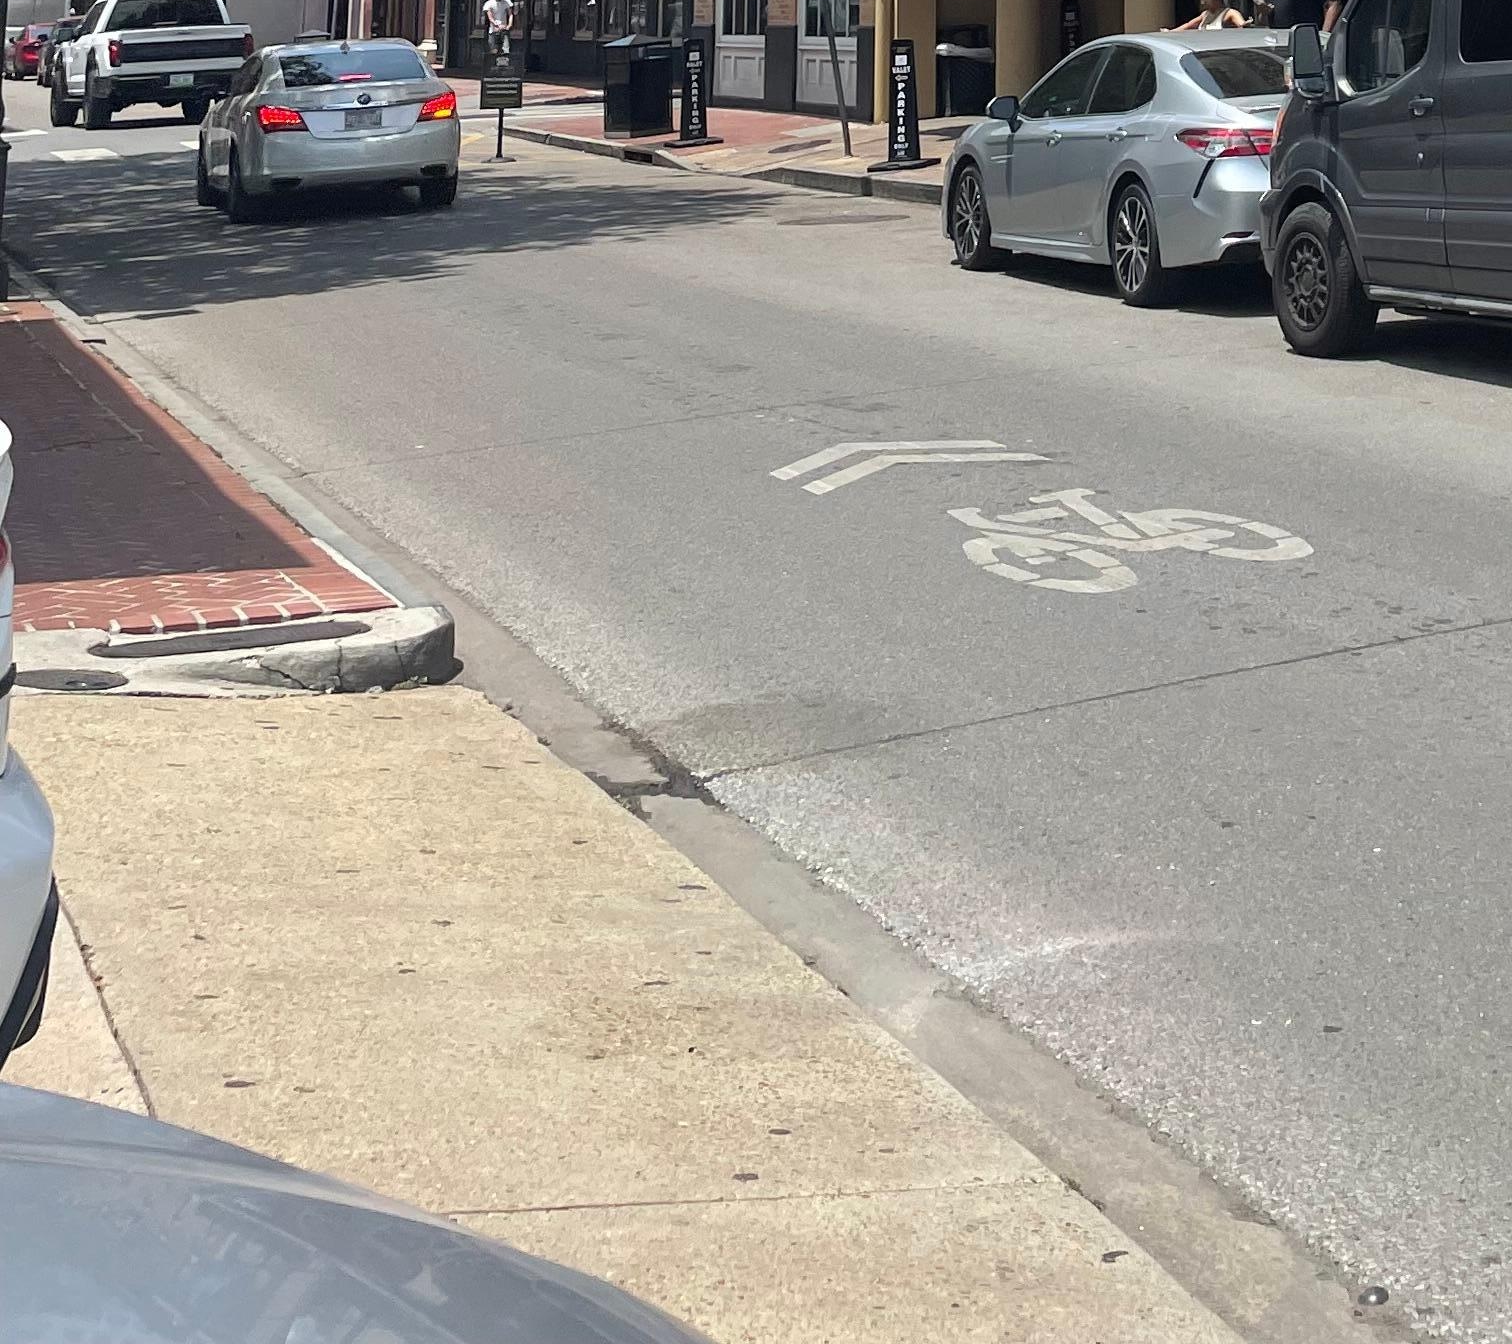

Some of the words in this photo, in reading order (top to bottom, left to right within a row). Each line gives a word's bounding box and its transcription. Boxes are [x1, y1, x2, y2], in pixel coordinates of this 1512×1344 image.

[891, 66, 911, 74] VALET
[691, 74, 700, 124] PARKING
[896, 82, 906, 143] PARKING
